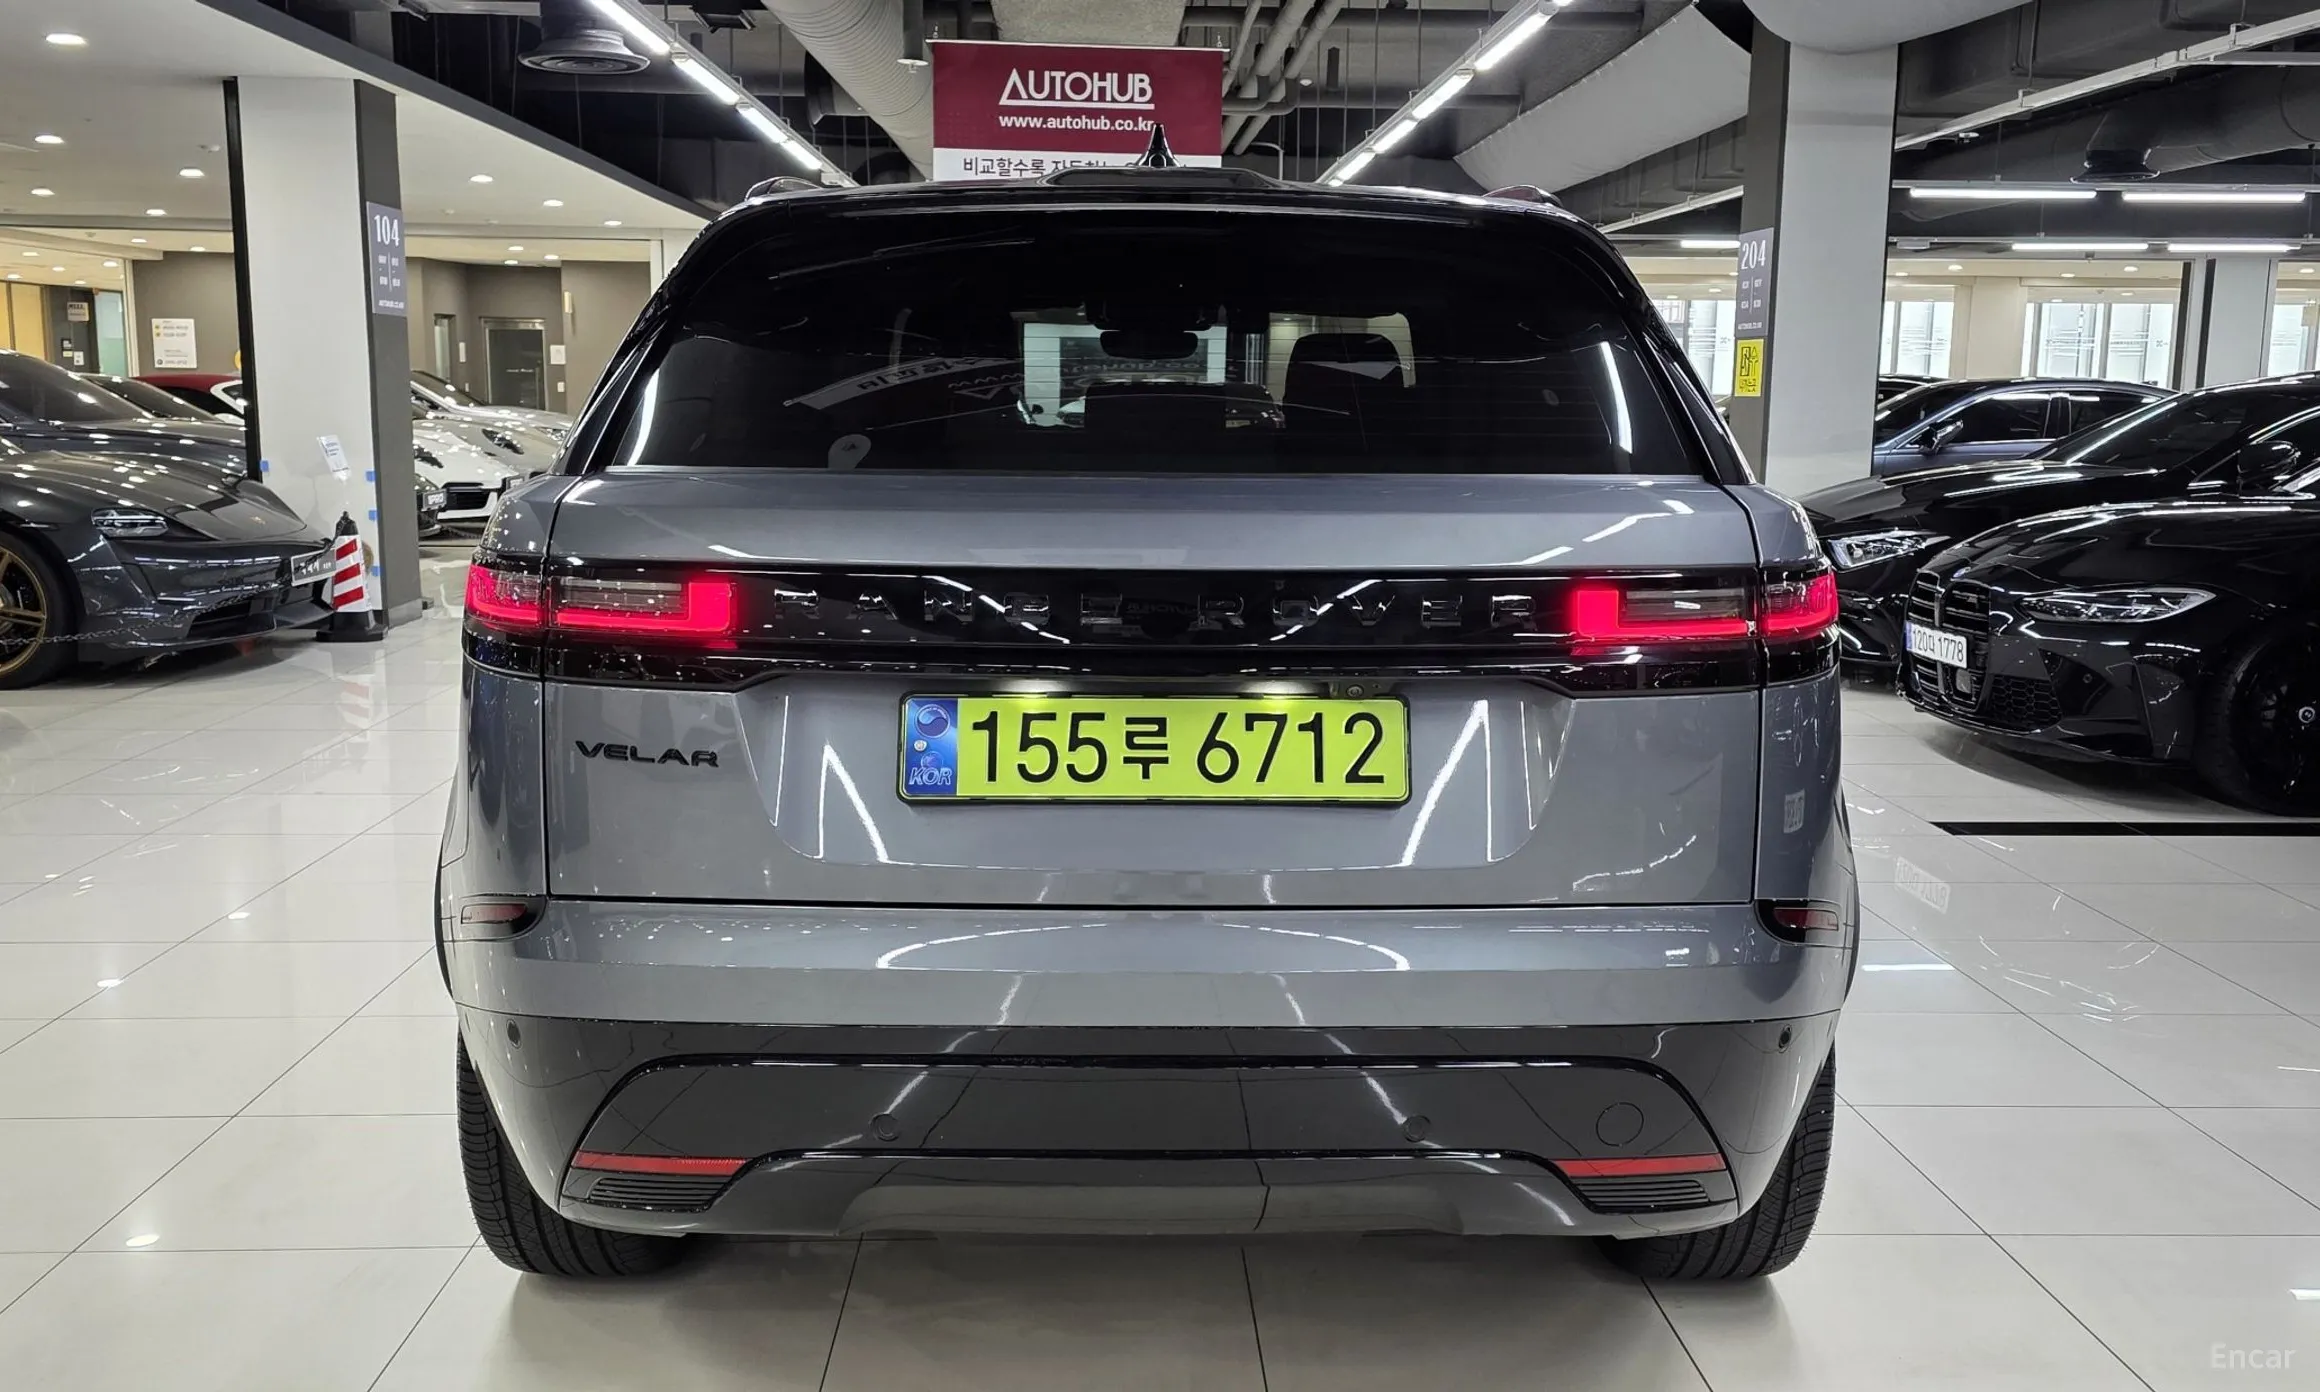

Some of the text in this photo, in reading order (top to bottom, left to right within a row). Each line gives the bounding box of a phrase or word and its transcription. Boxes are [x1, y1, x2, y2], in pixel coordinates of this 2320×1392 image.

[998, 68, 1155, 109] AUTOHUB
[999, 115, 1154, 131] www.autohub.co.kr
[963, 157, 1046, 177] 비교할수록
[374, 215, 400, 246] 104
[1741, 240, 1766, 269] 204
[774, 589, 1537, 631] RANGE ROVER
[1938, 636, 1964, 662] 1778
[575, 740, 719, 768] VELAR
[971, 710, 1386, 784] 155루 6712
[908, 767, 953, 786] KOR
